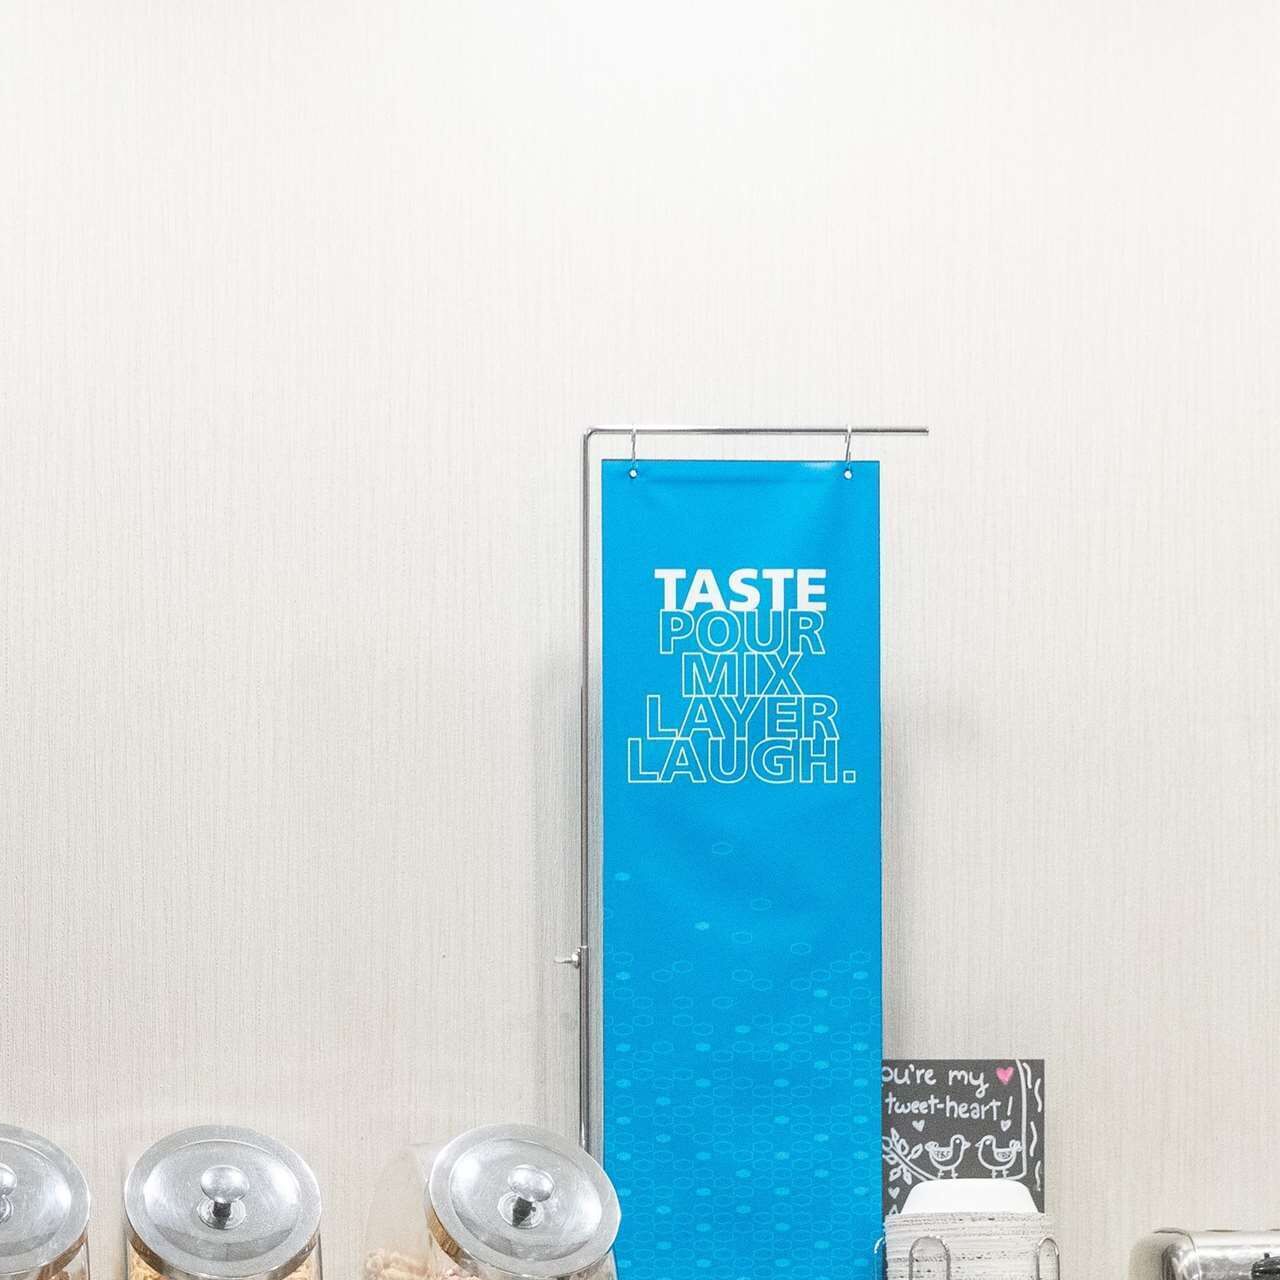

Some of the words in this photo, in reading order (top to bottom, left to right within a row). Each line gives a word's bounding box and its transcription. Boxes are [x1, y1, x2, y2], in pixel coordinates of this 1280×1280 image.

[654, 568, 827, 611] TASTE
[659, 608, 826, 655] POUR
[681, 652, 803, 698] MIX
[646, 694, 840, 741] LAYER
[627, 736, 857, 783] LAUGH.
[881, 1063, 937, 1085] ou're
[948, 1069, 990, 1099] my
